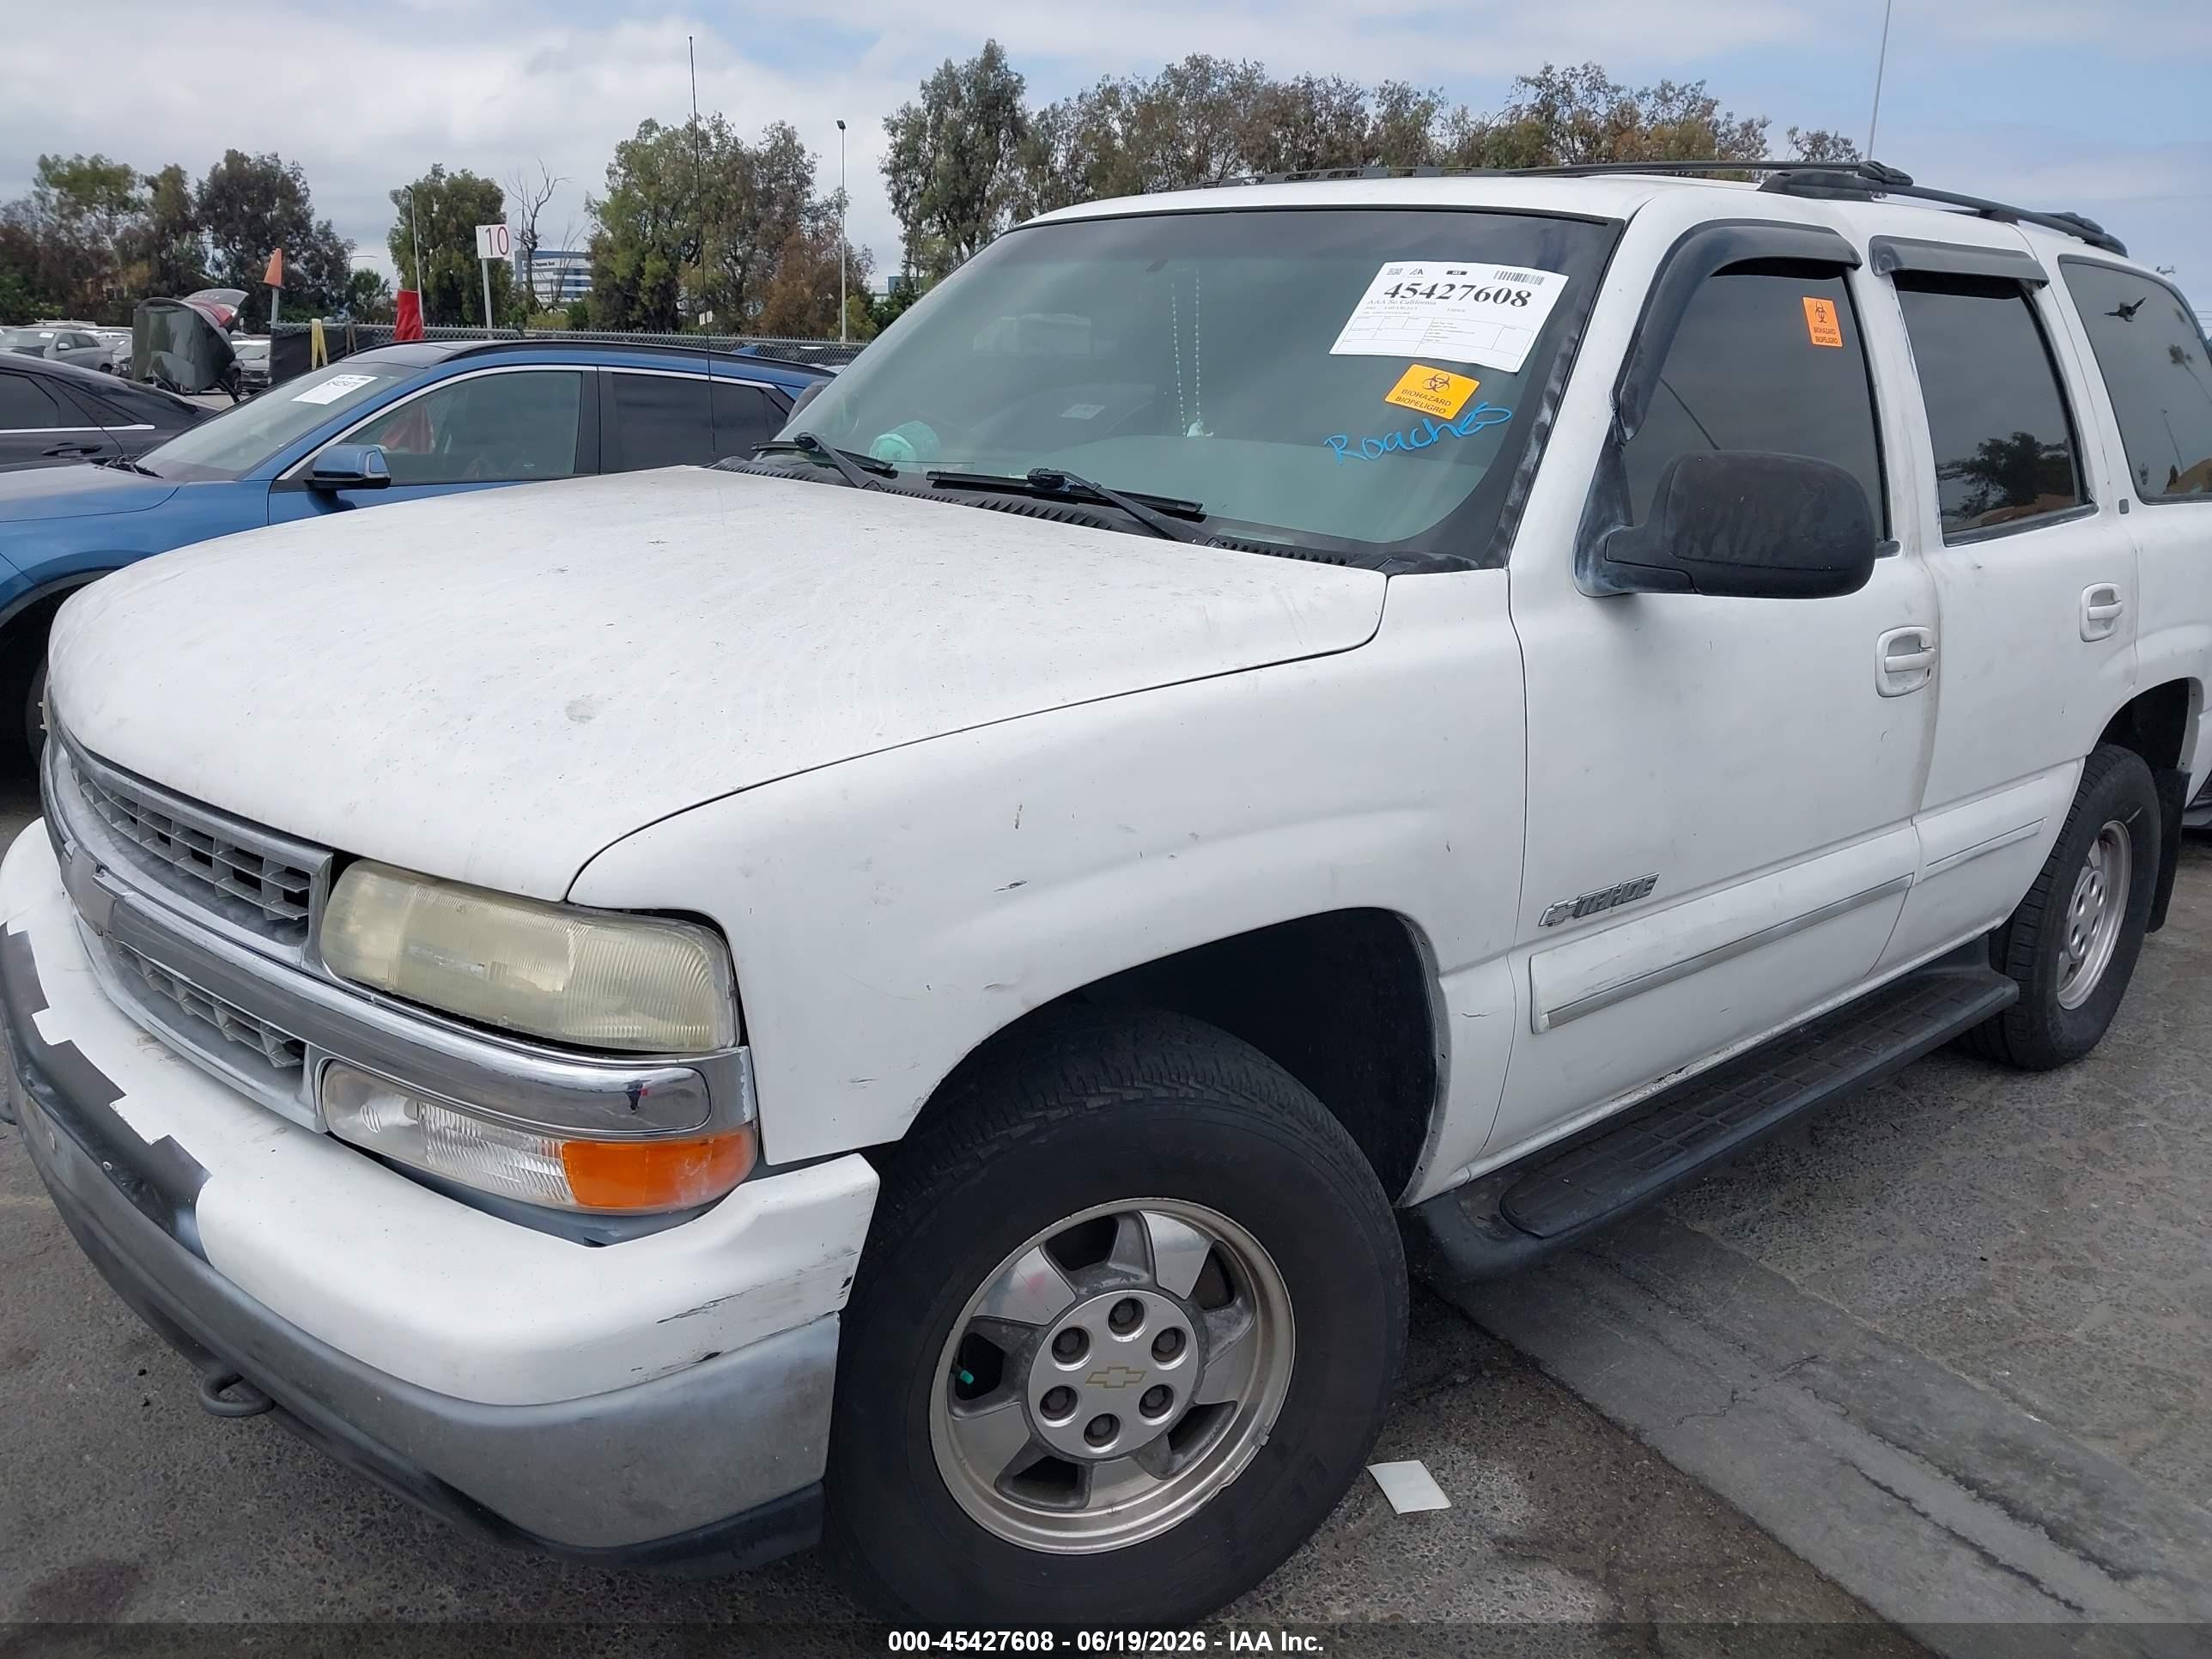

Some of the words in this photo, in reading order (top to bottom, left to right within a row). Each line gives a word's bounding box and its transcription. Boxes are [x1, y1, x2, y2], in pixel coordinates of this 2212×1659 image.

[485, 226, 509, 256] 10
[1383, 283, 1532, 307] 45427608
[1395, 395, 1446, 415] BIOPELIGRO
[1401, 388, 1452, 407] BIOHAZARD
[1577, 875, 1659, 917] TAHOE
